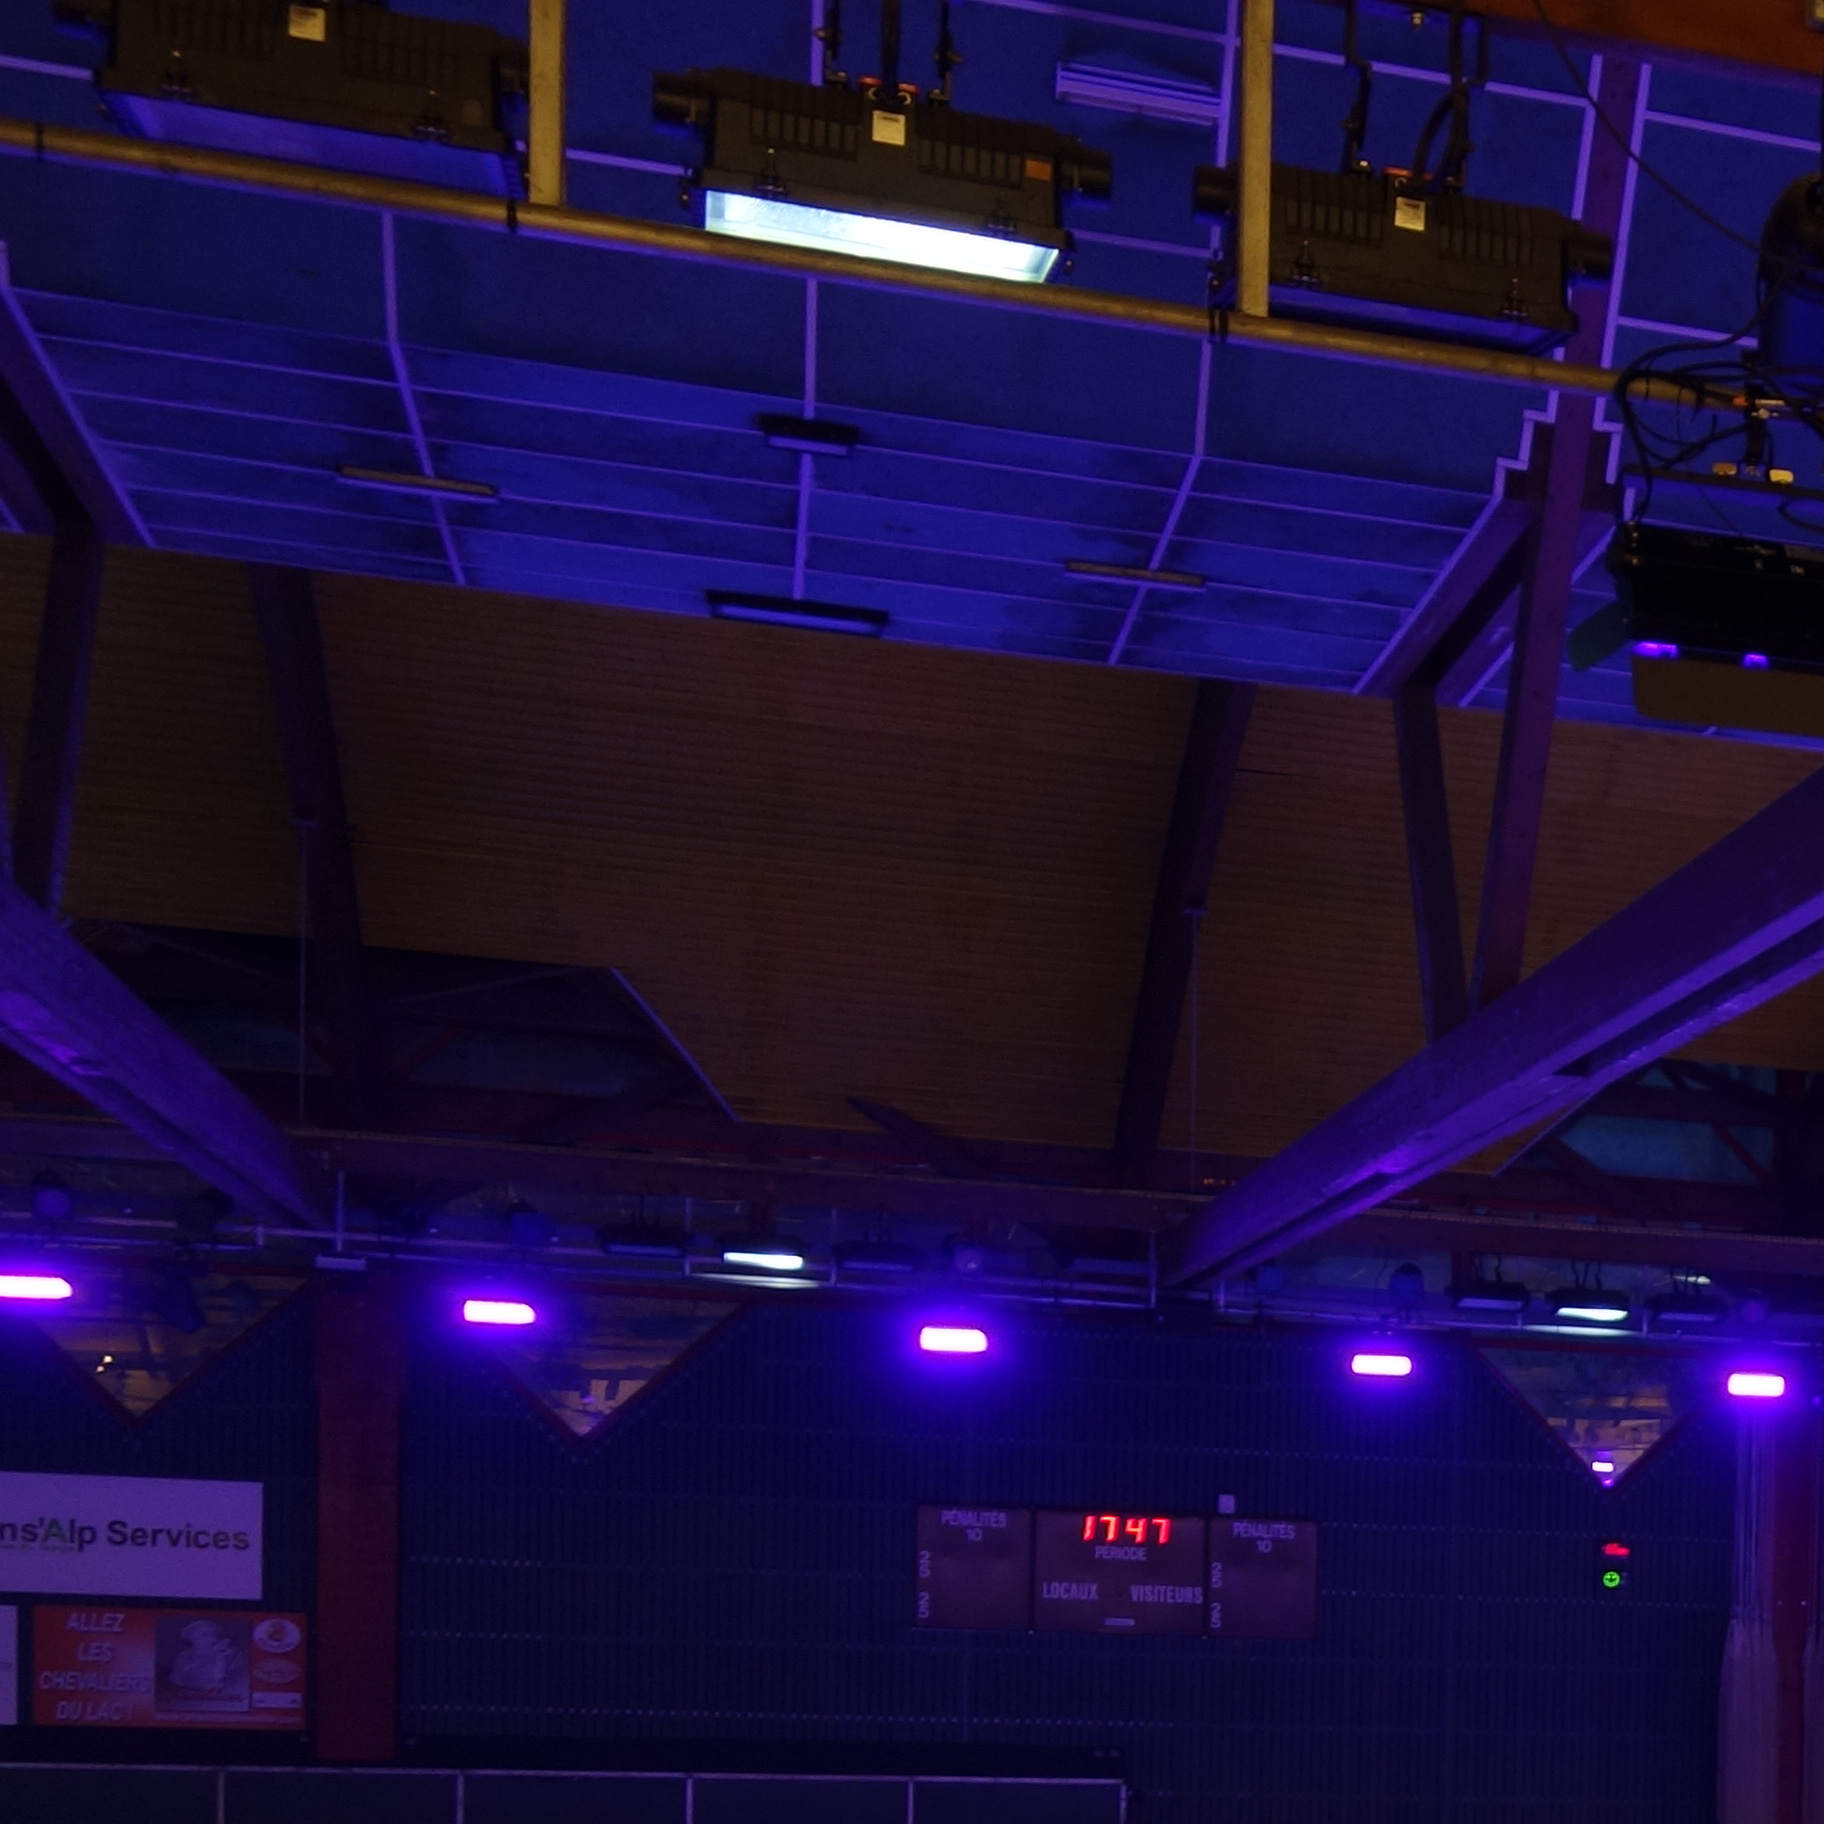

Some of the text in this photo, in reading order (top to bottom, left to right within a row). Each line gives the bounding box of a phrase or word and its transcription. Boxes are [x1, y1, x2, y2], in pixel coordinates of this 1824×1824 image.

[107, 1520, 250, 1550] Services
[966, 1527, 983, 1542] 10
[1256, 1539, 1272, 1553] 10
[1042, 1582, 1203, 1604] LOCAUX VISITEURS
[66, 1612, 125, 1633] ALLEZ
[77, 1642, 114, 1663] LES
[39, 1671, 153, 1693] CHEVALIERS
[55, 1700, 81, 1721] DU
[85, 1701, 123, 1721] LAC
